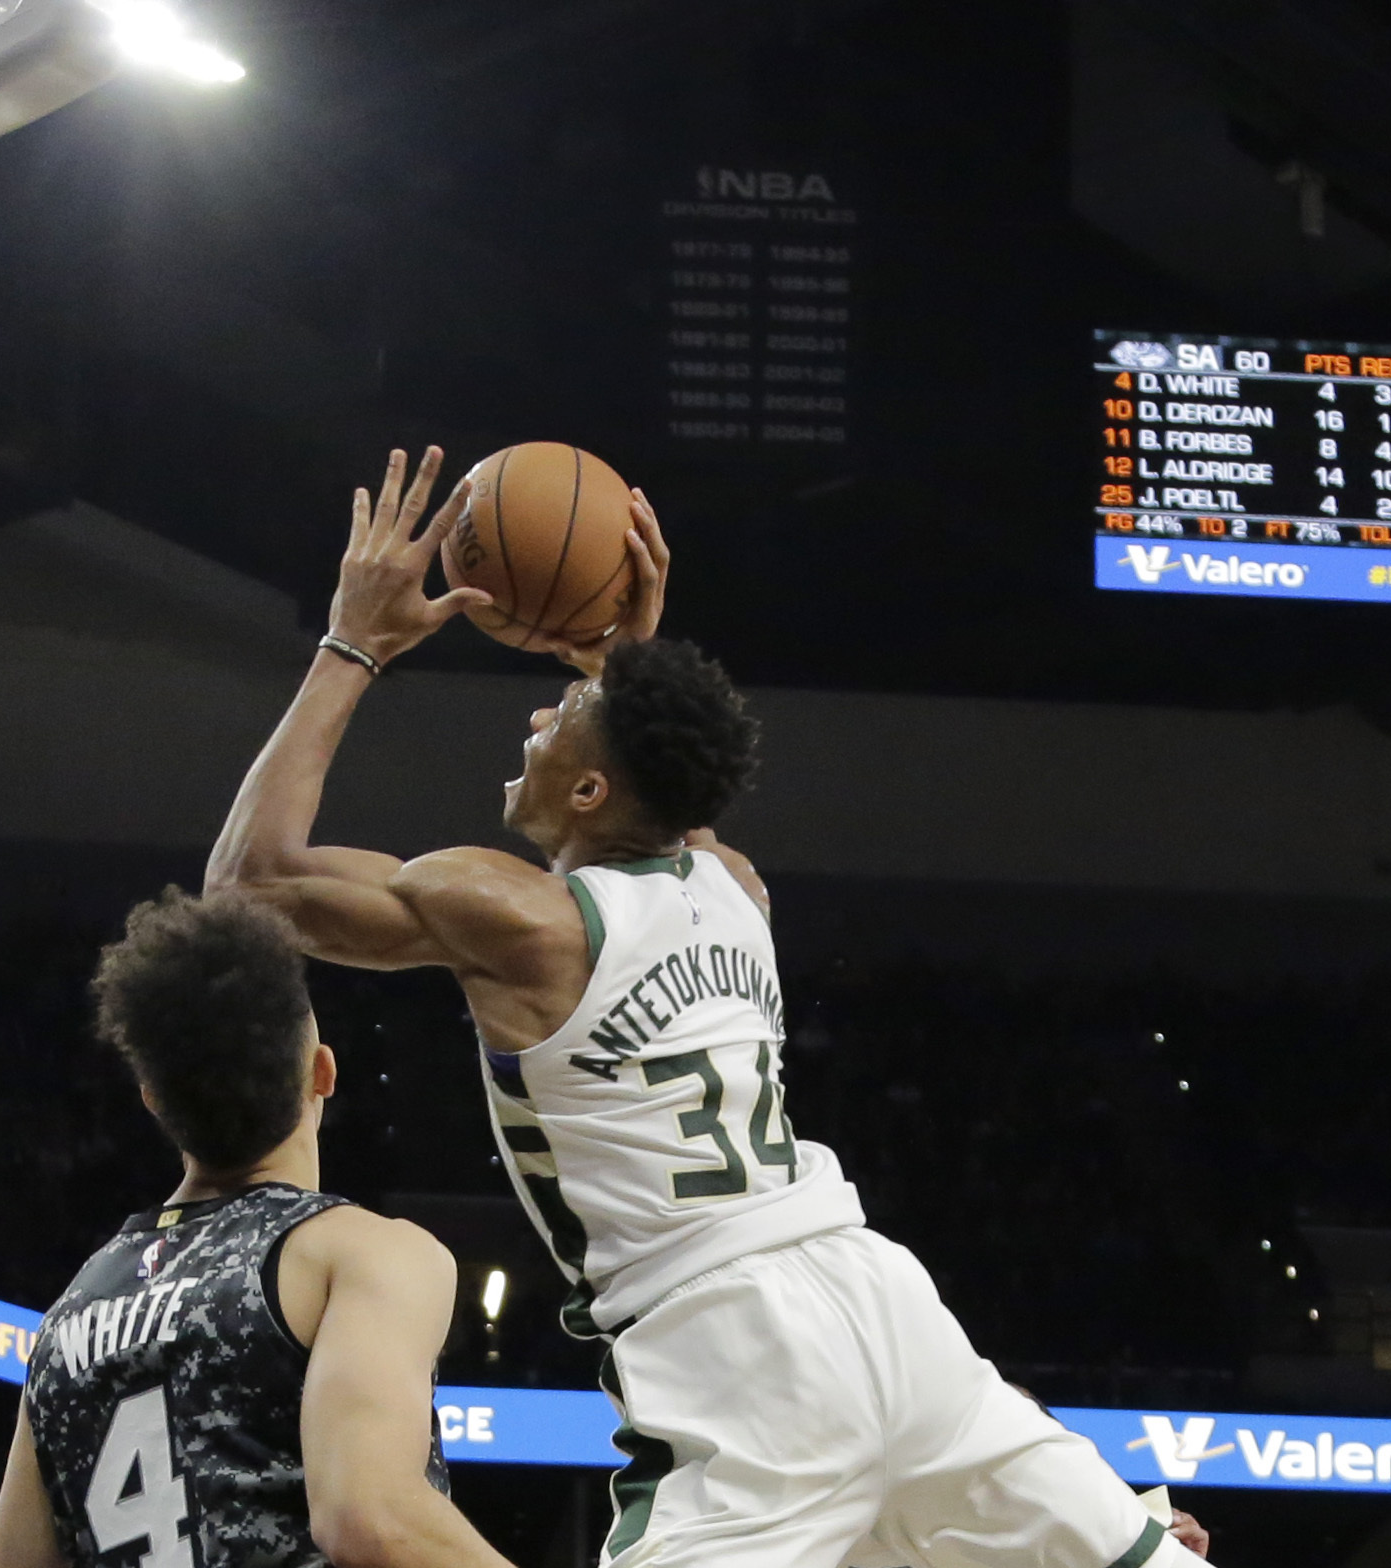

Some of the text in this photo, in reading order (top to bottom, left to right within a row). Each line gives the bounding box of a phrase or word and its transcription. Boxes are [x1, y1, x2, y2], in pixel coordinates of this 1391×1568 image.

[719, 168, 834, 201] NBA
[1177, 344, 1220, 371] SA
[1235, 351, 1271, 373] 60
[1304, 353, 1352, 376] PTS
[1113, 372, 1132, 391] 4
[1138, 373, 1162, 393] D.
[1166, 374, 1240, 397] WHITE
[1318, 382, 1336, 403] 4
[1103, 399, 1133, 419] 10
[1138, 401, 1162, 422] D.
[1165, 403, 1275, 428] DEROZAN
[1314, 410, 1345, 431] 16
[1378, 413, 1391, 433] 1
[1103, 428, 1130, 448] 11
[1138, 429, 1162, 450] B.
[1165, 431, 1252, 455] FORBES
[1318, 439, 1338, 460] 8
[1103, 456, 1133, 477] 12
[1138, 458, 1159, 479] L.
[1162, 459, 1273, 485] ALDRIDGE
[1315, 467, 1345, 488] 14
[1100, 485, 1133, 506] 25
[1138, 487, 1160, 508] J.
[1163, 488, 1246, 512] POELTL
[1319, 496, 1338, 516] 4
[1105, 514, 1134, 531] FG
[1136, 515, 1184, 535] 44%
[1197, 518, 1225, 536] TO
[1231, 520, 1247, 538] 2
[1265, 521, 1291, 538] FT
[1295, 523, 1340, 542] 75%
[1182, 552, 1307, 588] Valero
[569, 944, 786, 1082] ANTETOKOUNMP
[639, 1040, 799, 1204] 34
[58, 1276, 199, 1380] WHITE
